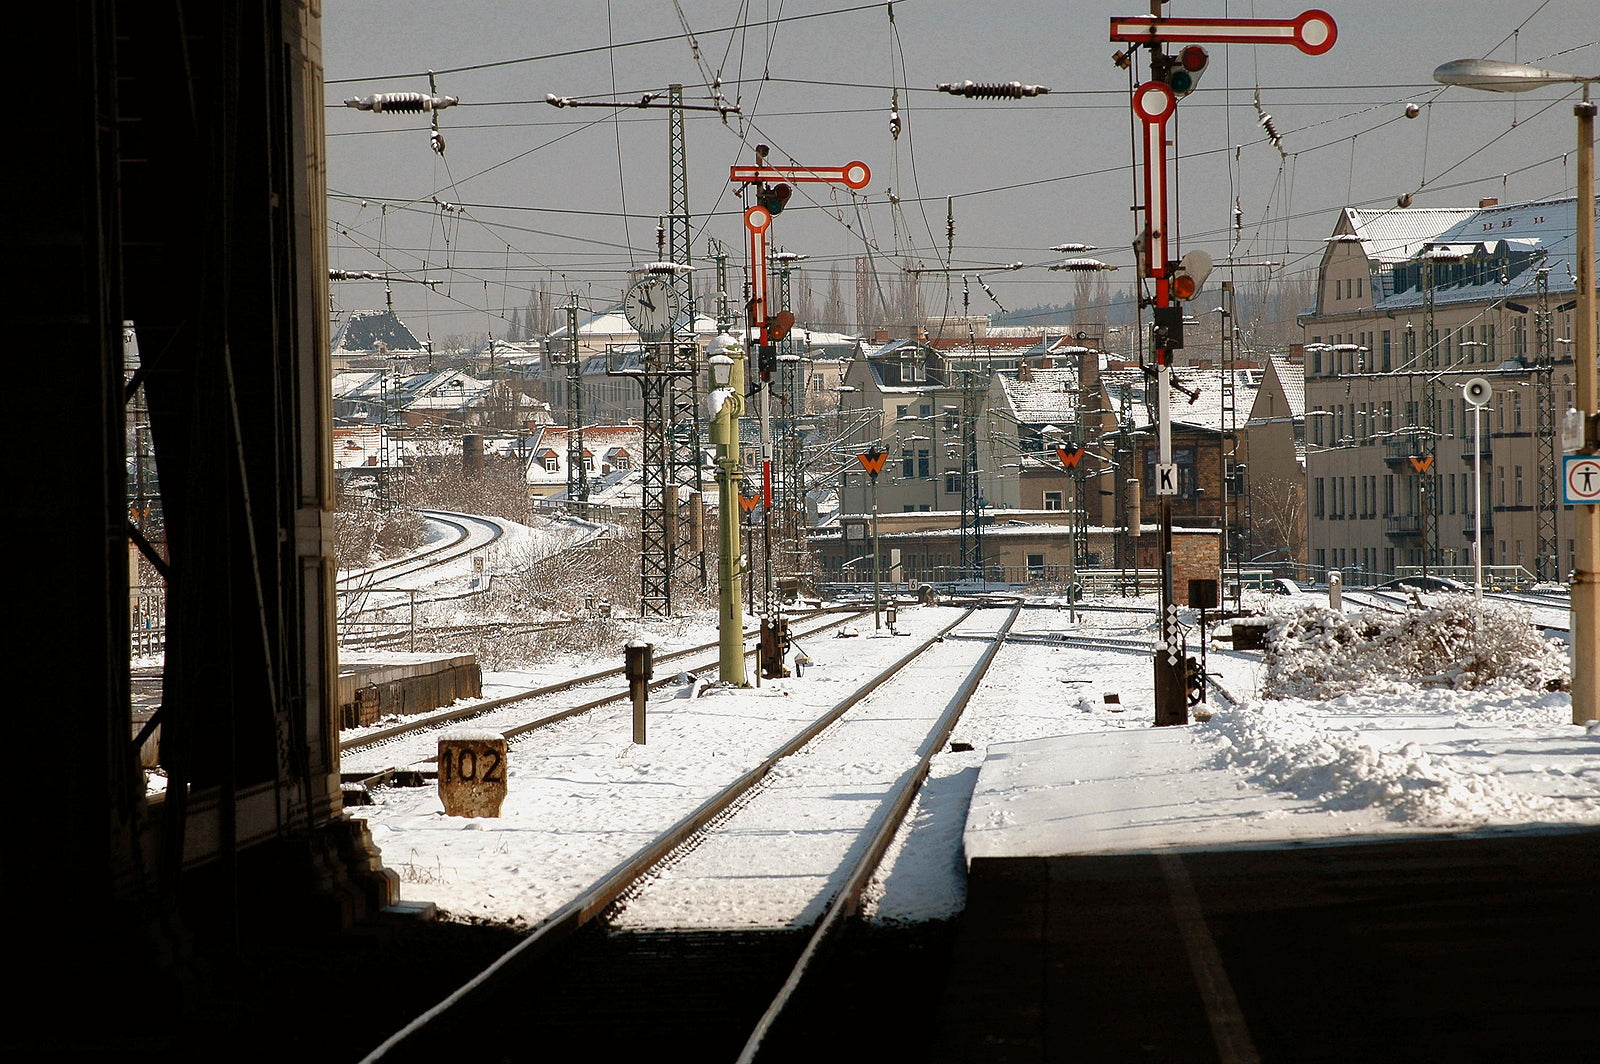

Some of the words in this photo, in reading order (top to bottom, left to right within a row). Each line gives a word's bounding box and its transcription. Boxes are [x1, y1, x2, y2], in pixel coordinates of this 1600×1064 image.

[762, 445, 770, 458] L
[1056, 448, 1085, 468] W
[857, 452, 888, 474] W
[1410, 457, 1434, 472] W
[1161, 468, 1173, 489] K
[738, 494, 761, 511] W
[911, 580, 916, 589] 6
[442, 749, 501, 782] 102
